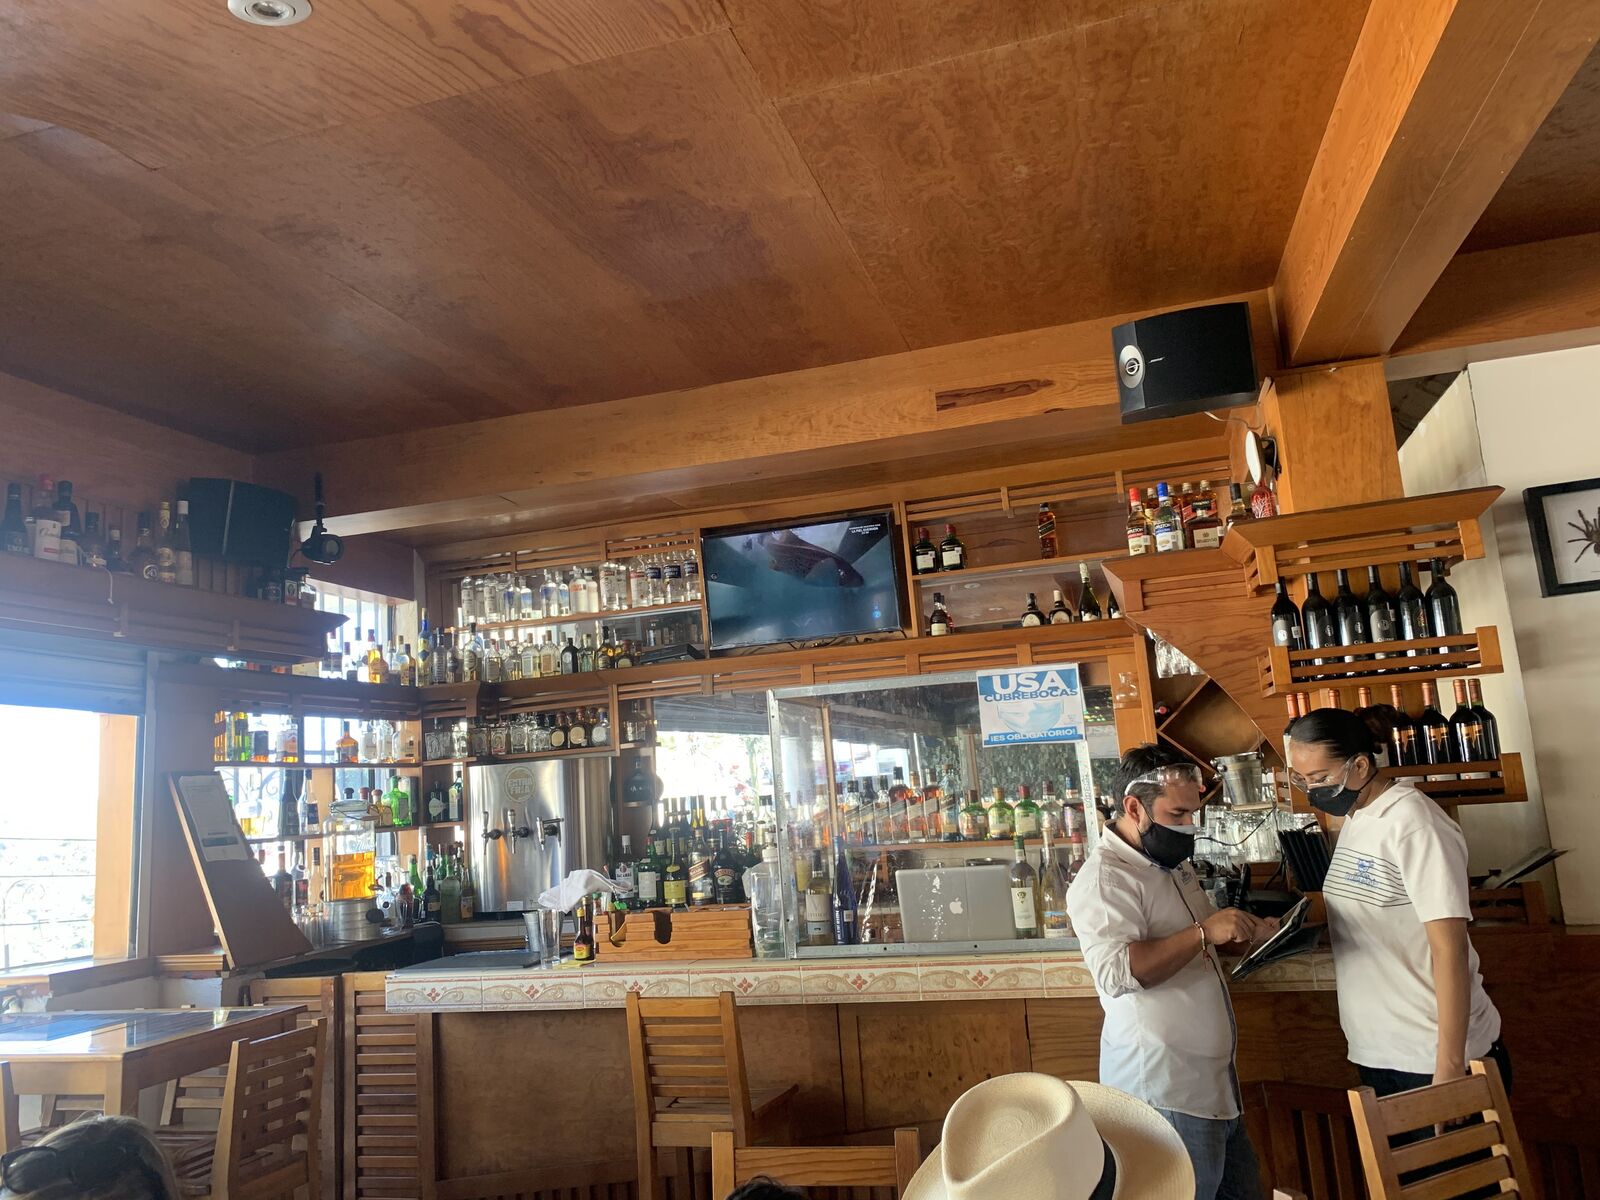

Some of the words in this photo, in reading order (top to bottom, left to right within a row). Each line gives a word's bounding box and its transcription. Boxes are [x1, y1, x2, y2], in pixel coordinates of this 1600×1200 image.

[992, 670, 1068, 695] USA
[984, 688, 1078, 703] CUBREBOCAS
[1007, 728, 1076, 740] OBLIGATORIO!
